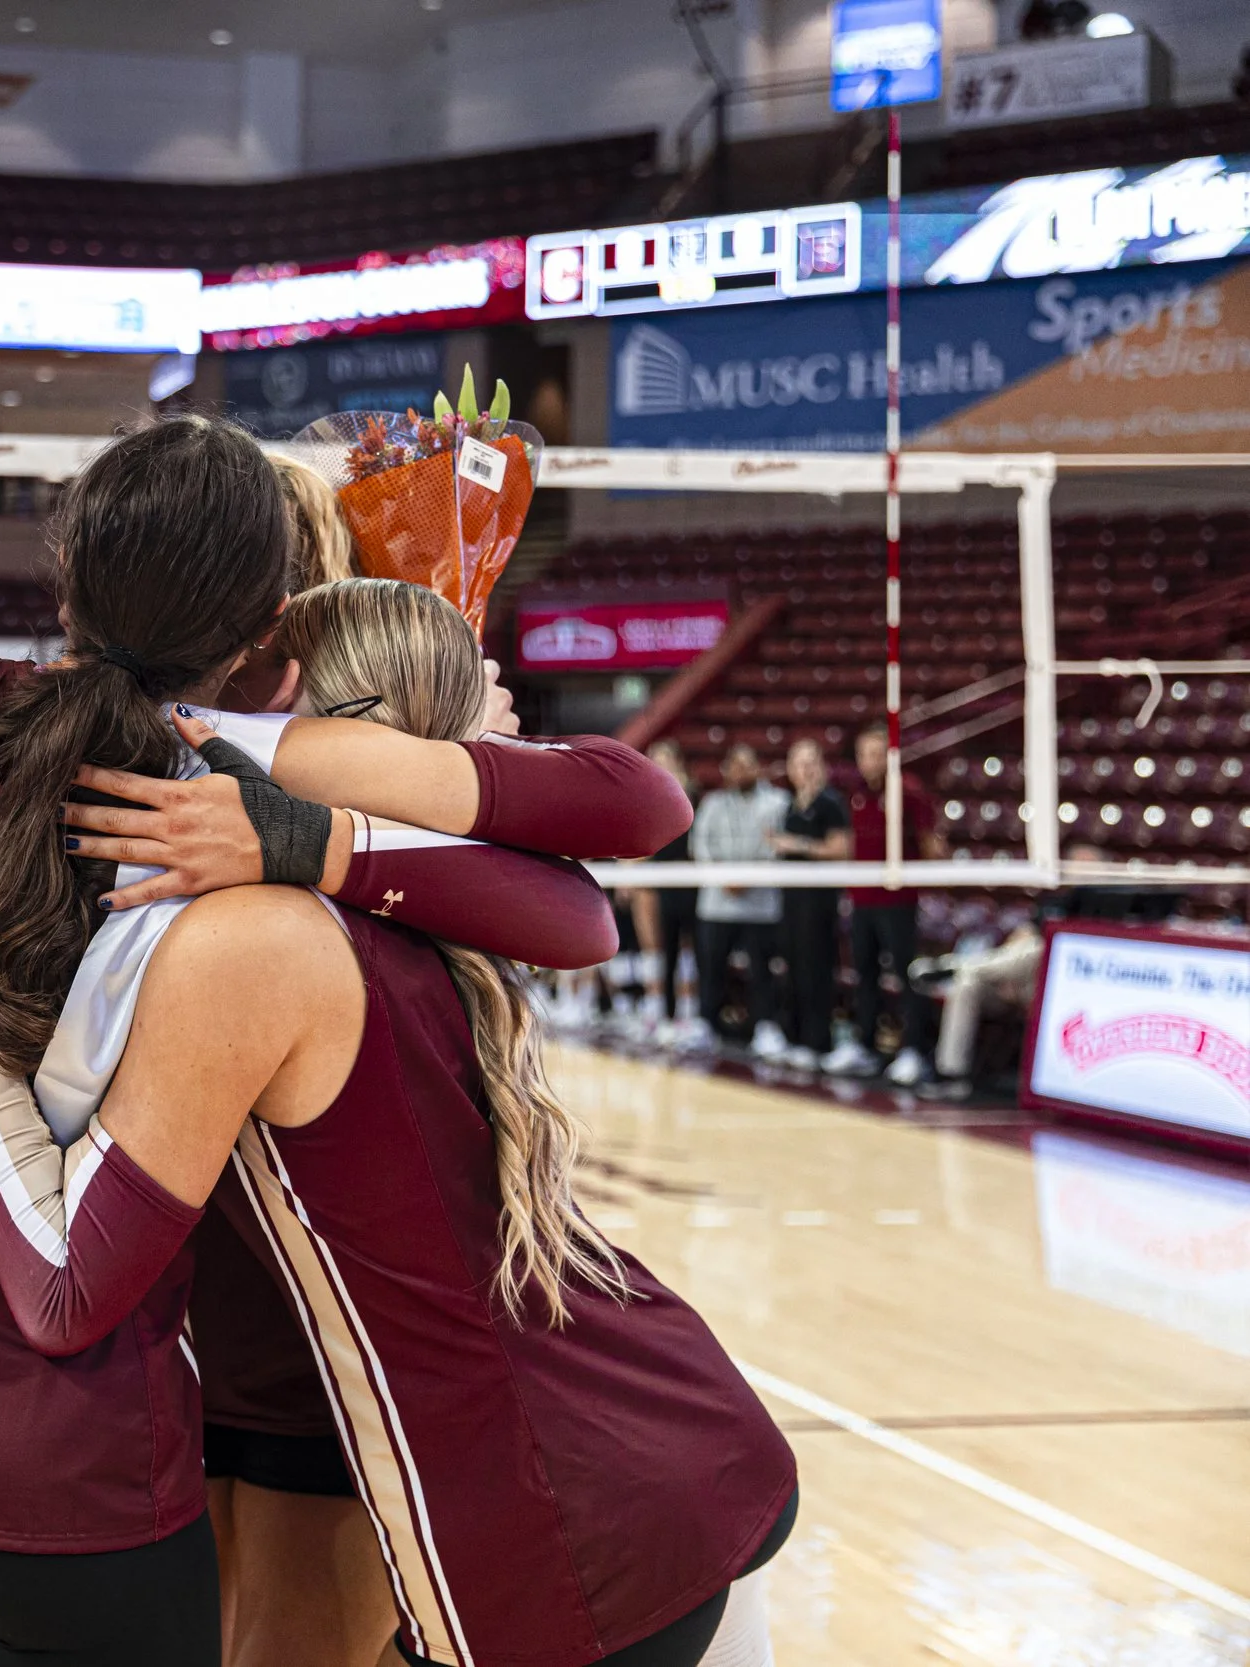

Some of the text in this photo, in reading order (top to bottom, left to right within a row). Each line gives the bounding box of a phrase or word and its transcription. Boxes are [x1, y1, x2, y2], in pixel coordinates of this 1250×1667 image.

[1029, 279, 1222, 355] Sports
[688, 341, 1006, 412] MUSC Health
